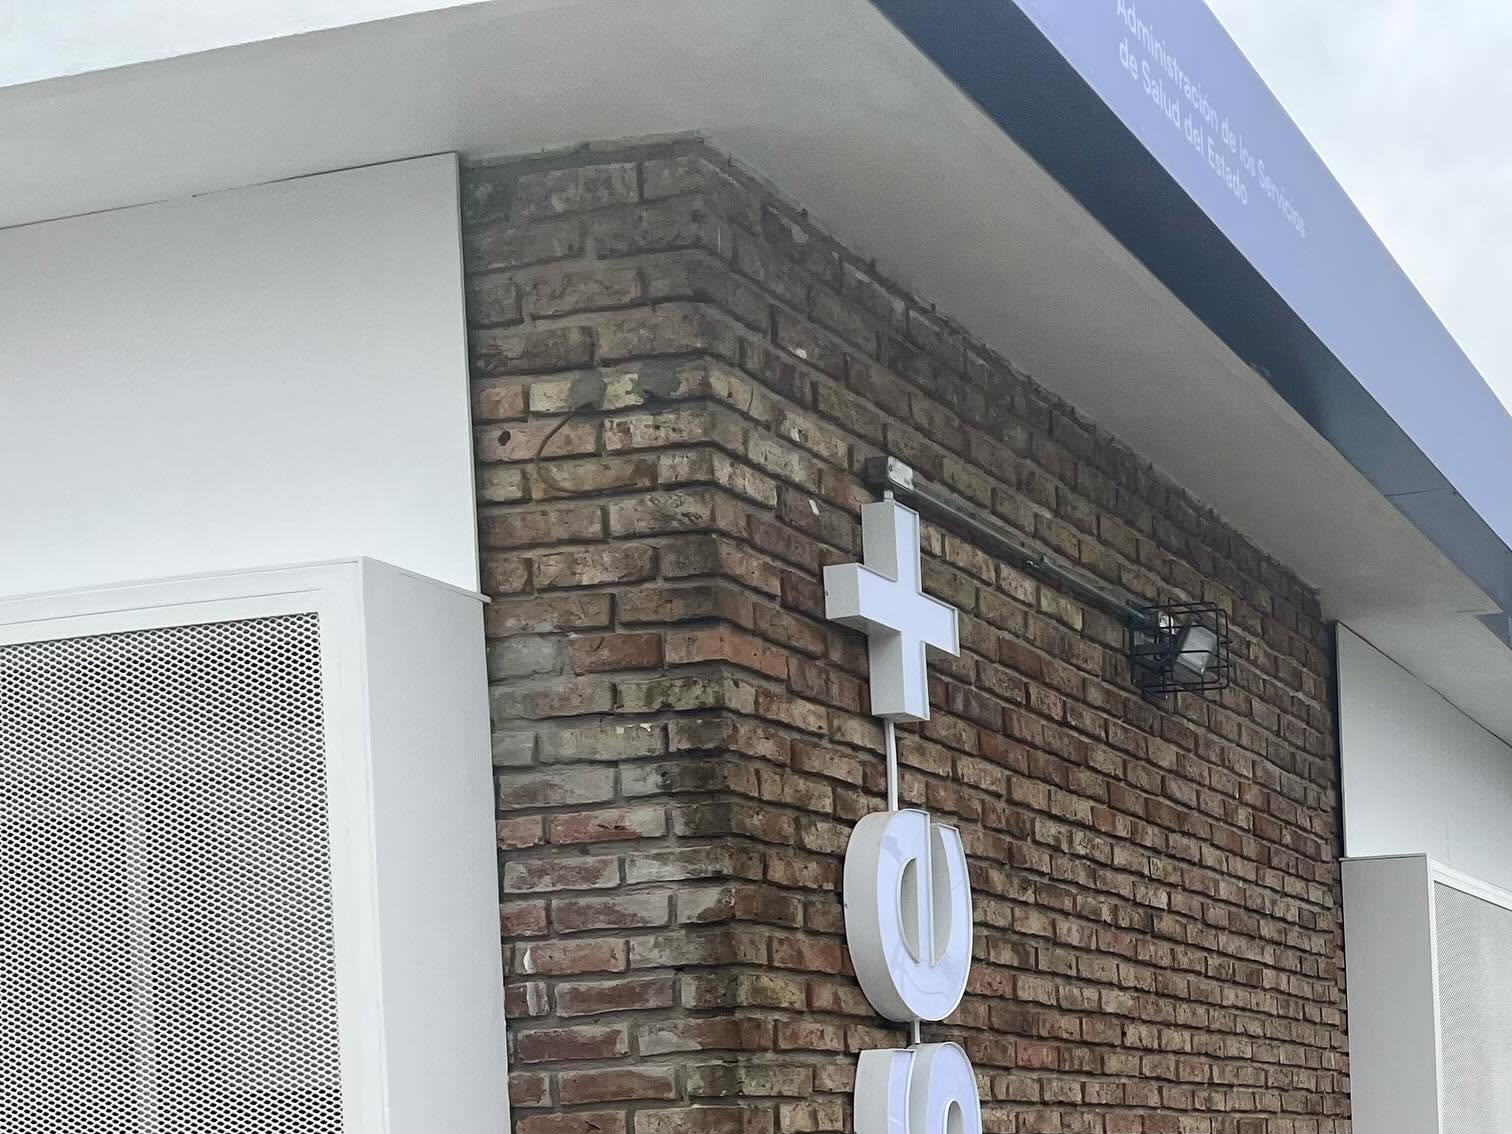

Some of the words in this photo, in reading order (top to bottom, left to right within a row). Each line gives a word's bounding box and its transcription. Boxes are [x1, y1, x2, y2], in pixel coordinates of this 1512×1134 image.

[1117, 0, 1218, 132] Administración
[1221, 117, 1236, 153] de
[1239, 134, 1256, 178] los
[1257, 158, 1305, 239] Servicios
[1119, 38, 1138, 81] de
[1141, 58, 1181, 131] Salud
[1184, 113, 1204, 157] del
[1207, 134, 1248, 206] Estado
